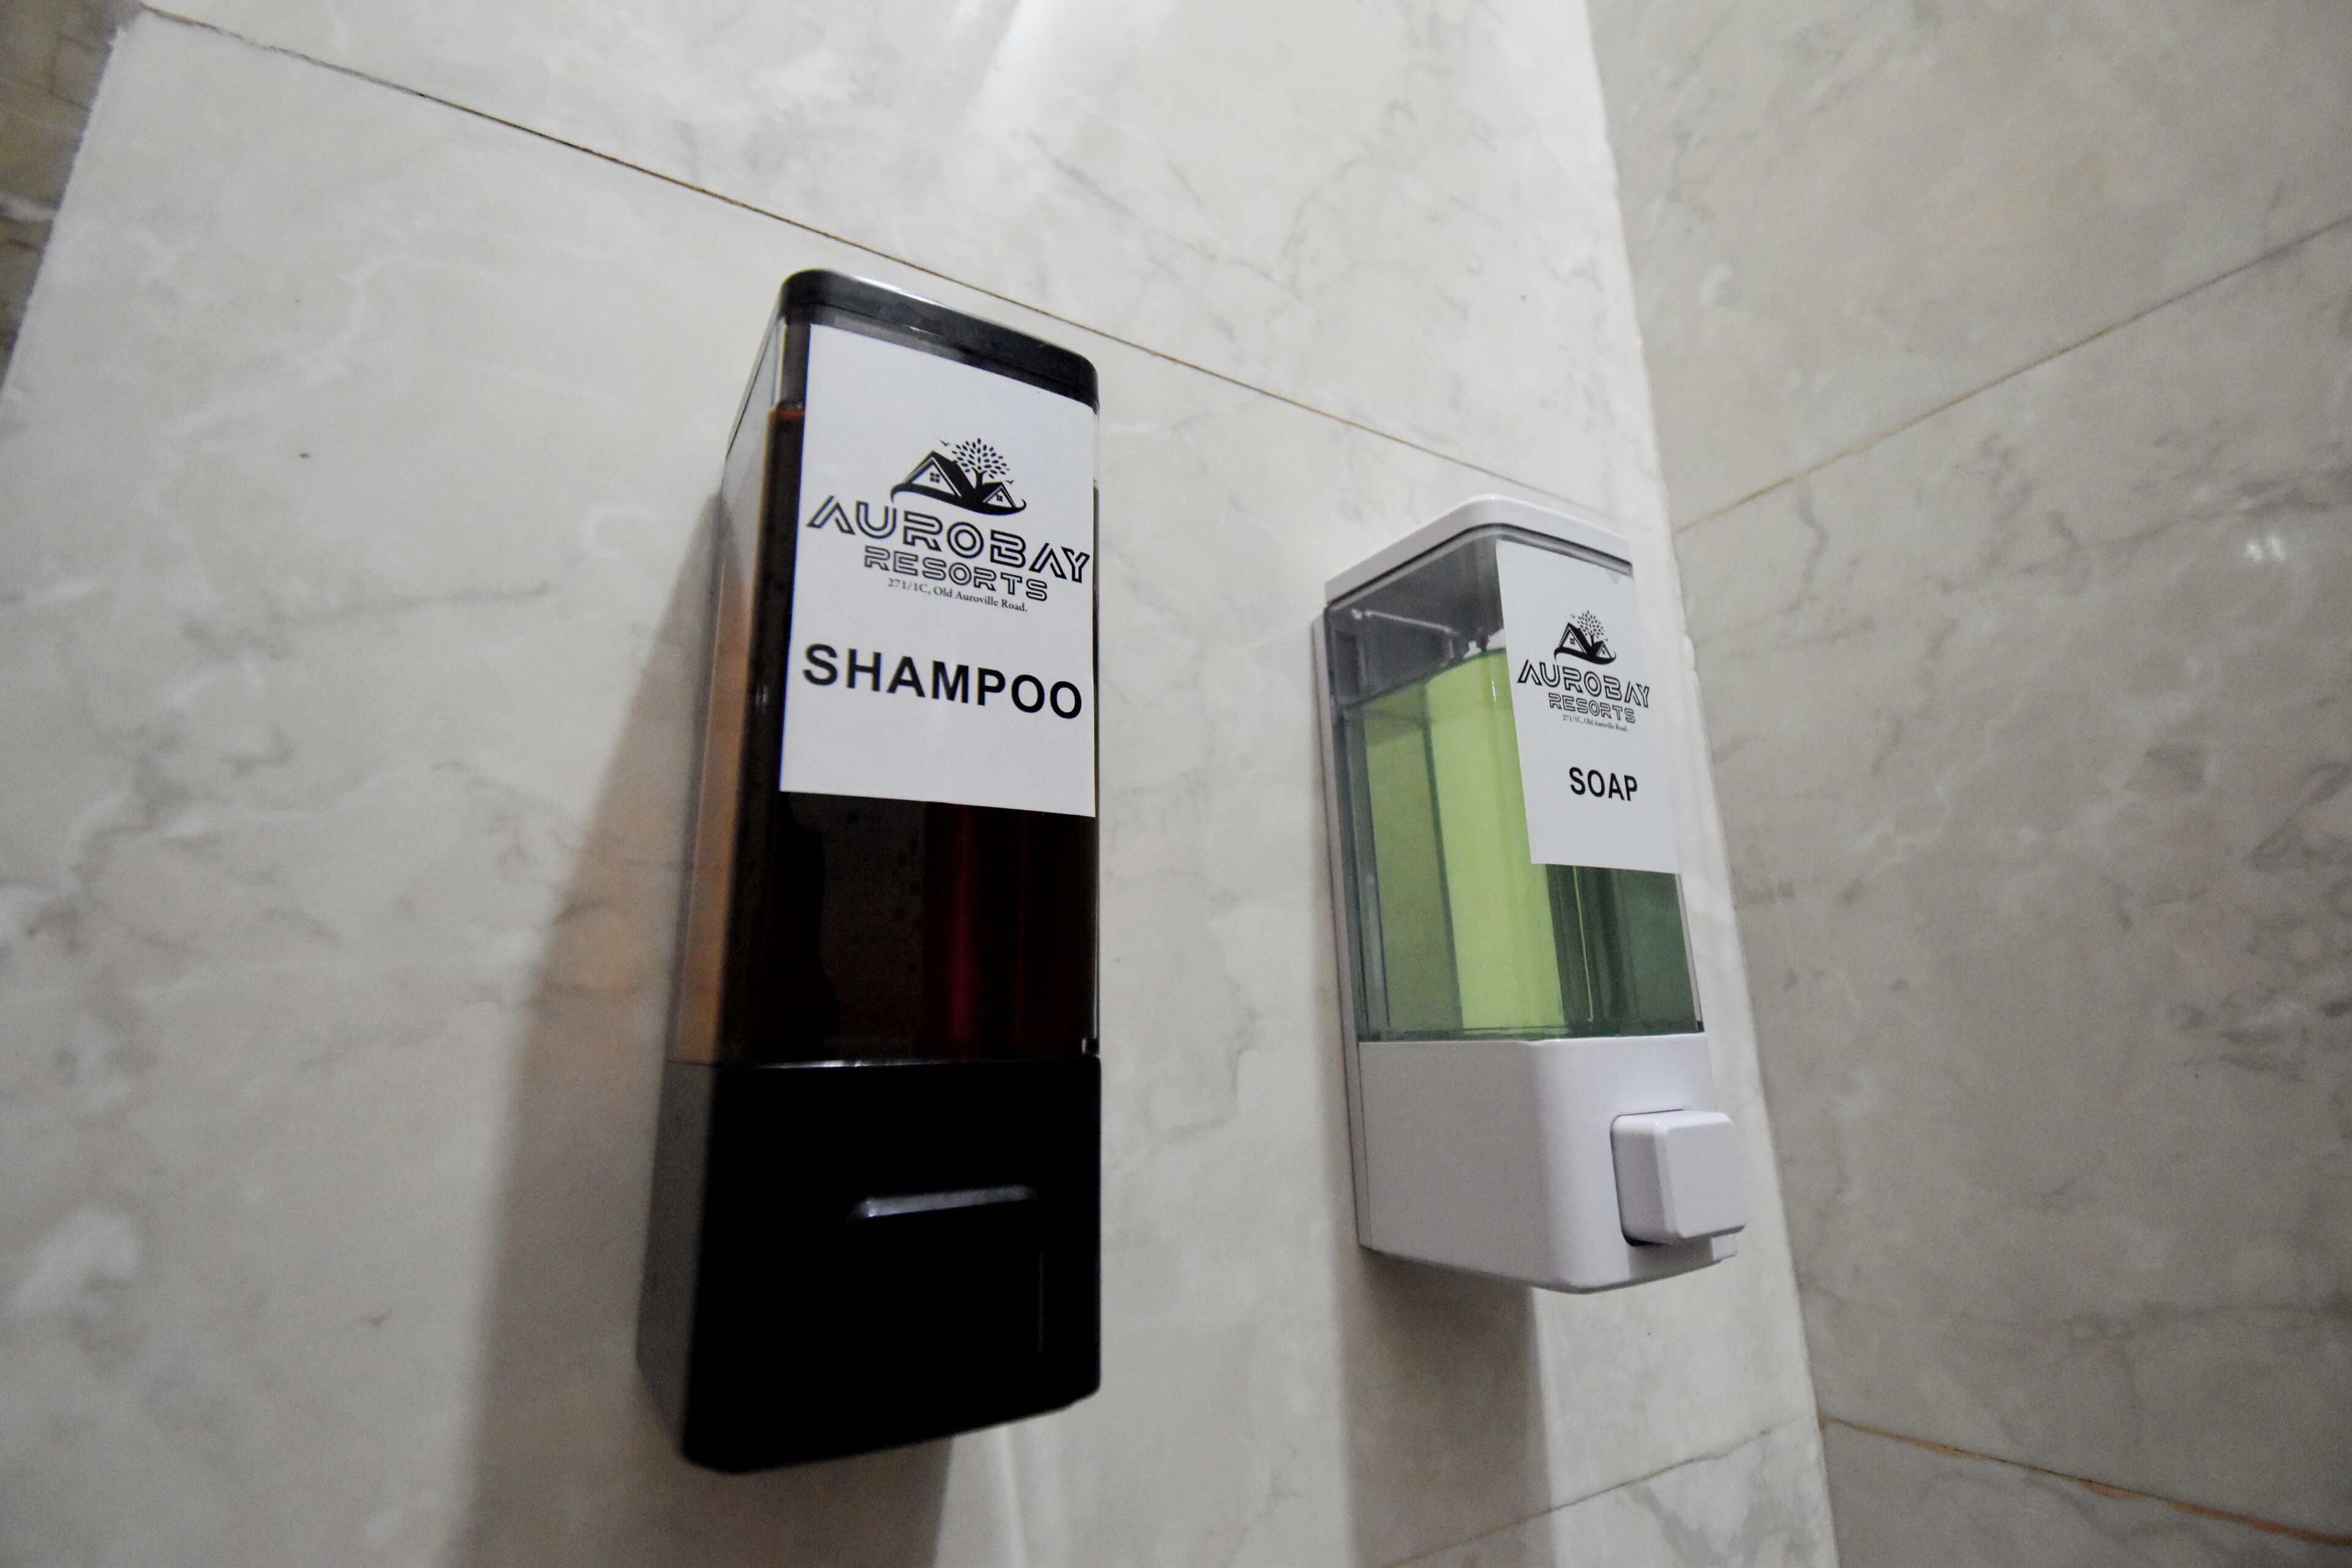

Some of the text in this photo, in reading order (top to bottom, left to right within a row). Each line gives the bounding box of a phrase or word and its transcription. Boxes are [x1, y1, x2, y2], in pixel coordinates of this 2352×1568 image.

[807, 496, 1090, 583] AUROBAY
[864, 545, 1048, 601] RESORTS
[888, 578, 1028, 612] 271/1C, Old Auroville Road.
[802, 643, 1082, 719] SHAMPOO
[1517, 659, 1649, 708] AUROBAY
[1548, 693, 1636, 724] RESORTS
[1569, 767, 1638, 801] SOAP
